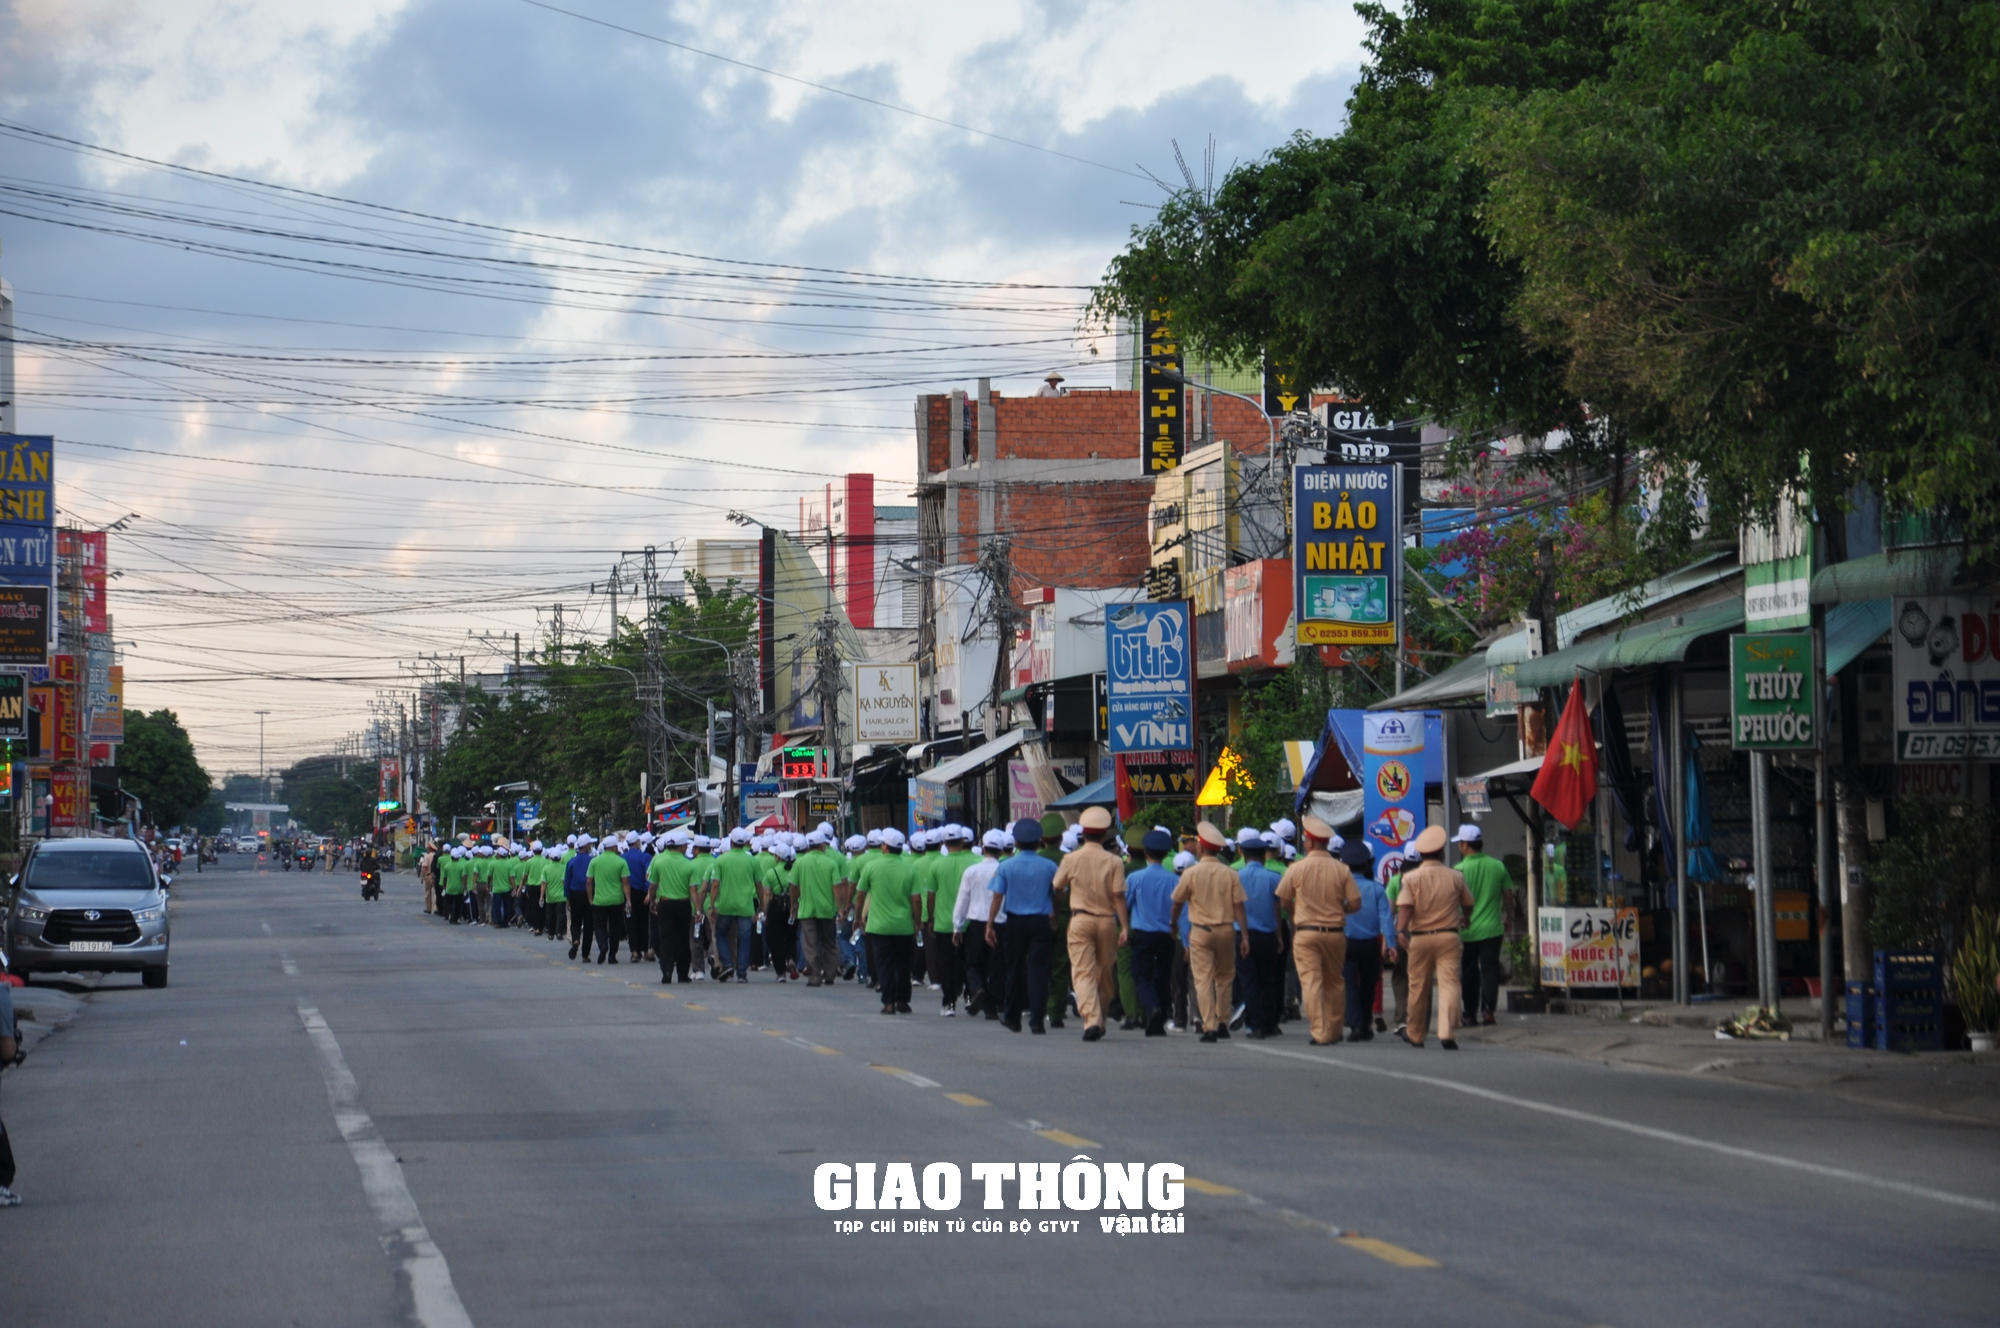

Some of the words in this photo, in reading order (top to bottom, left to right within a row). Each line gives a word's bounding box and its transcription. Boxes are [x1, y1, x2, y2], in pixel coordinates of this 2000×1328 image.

[1304, 470, 1340, 493] ĐIỆN
[1345, 470, 1388, 490] NƯỚC
[1313, 491, 1377, 530] BẢO
[1305, 535, 1385, 575] NHẬT
[1320, 629, 1348, 638] 02553
[865, 717, 884, 725] HAIR
[884, 717, 909, 726] SALON
[1738, 705, 1811, 742] PHƯỚC
[1570, 912, 1594, 942] CÀ
[1599, 912, 1636, 942] PHÊ
